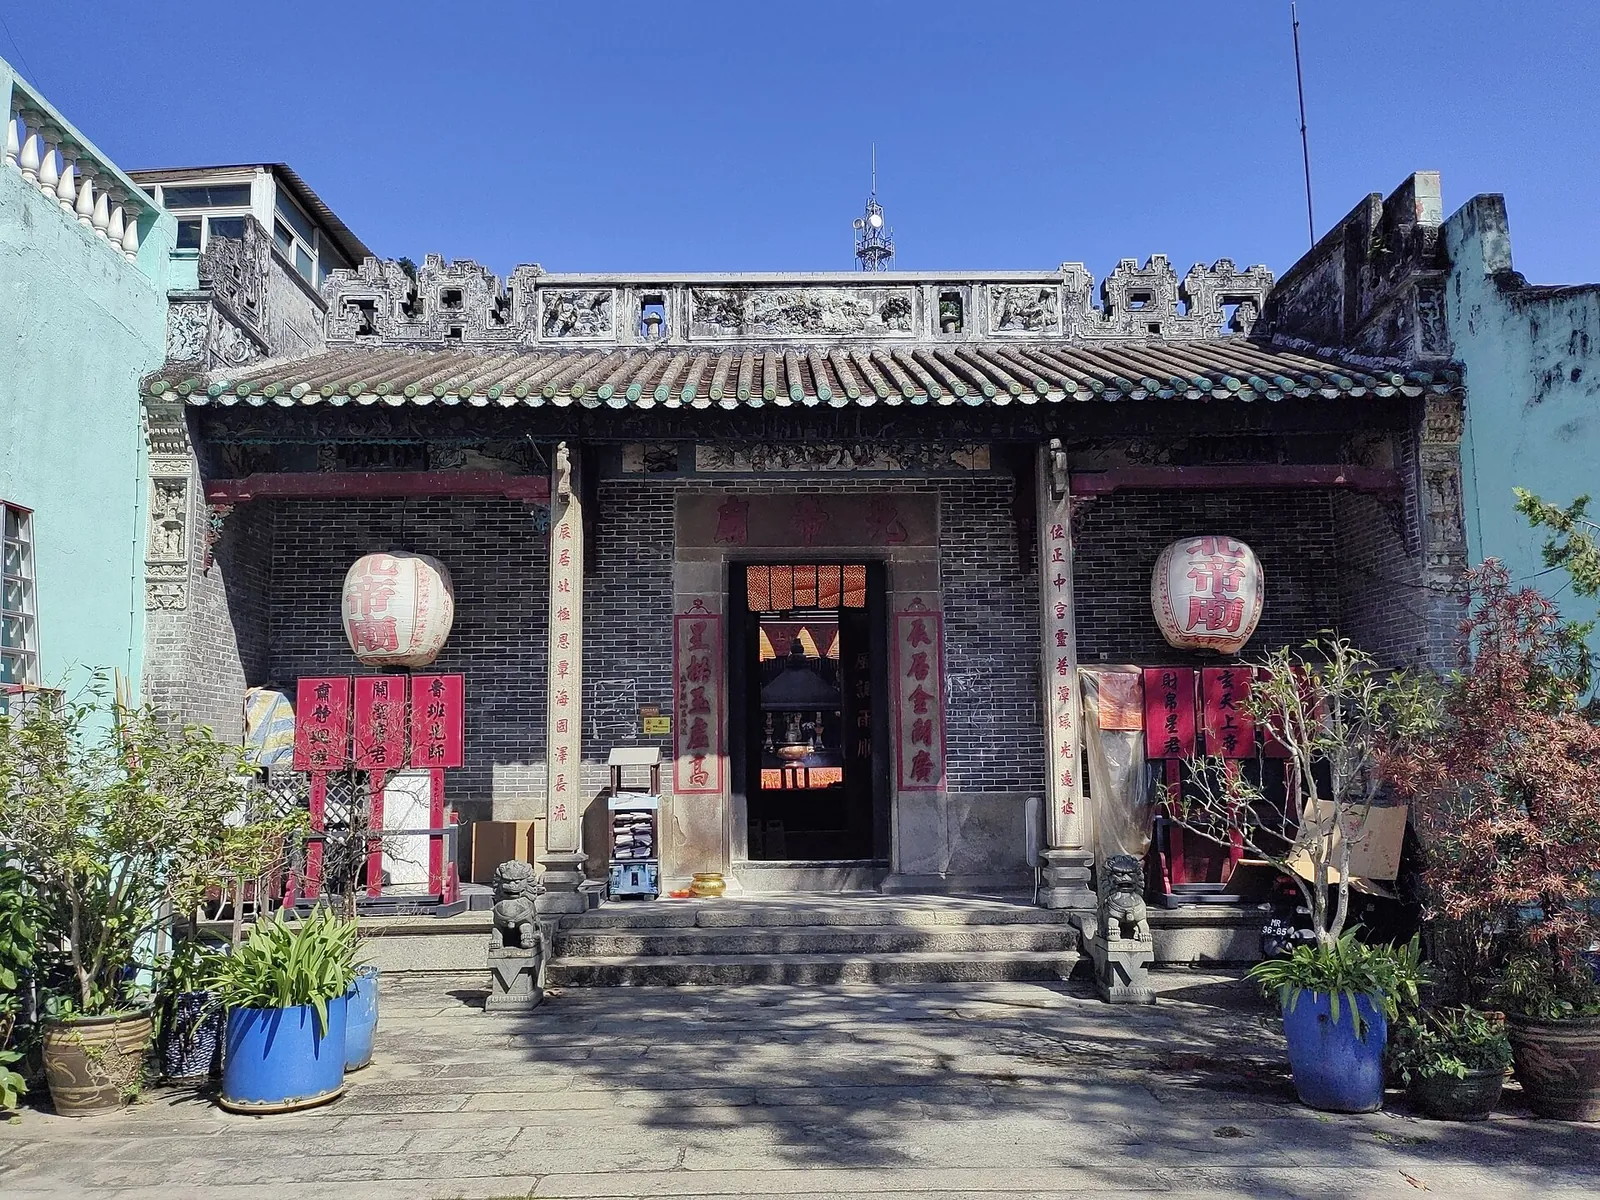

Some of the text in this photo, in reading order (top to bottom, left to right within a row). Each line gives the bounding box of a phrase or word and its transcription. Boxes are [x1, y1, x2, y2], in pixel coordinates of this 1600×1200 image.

[346, 554, 399, 653] 北帝廟
[1185, 536, 1246, 633] 北帝廟
[427, 678, 446, 763] 魯班先師
[1161, 672, 1181, 755] 財帛星君
[1216, 670, 1239, 755] 玄天上帝
[1262, 926, 1287, 936] 36-85
[1270, 918, 1281, 927] MR
